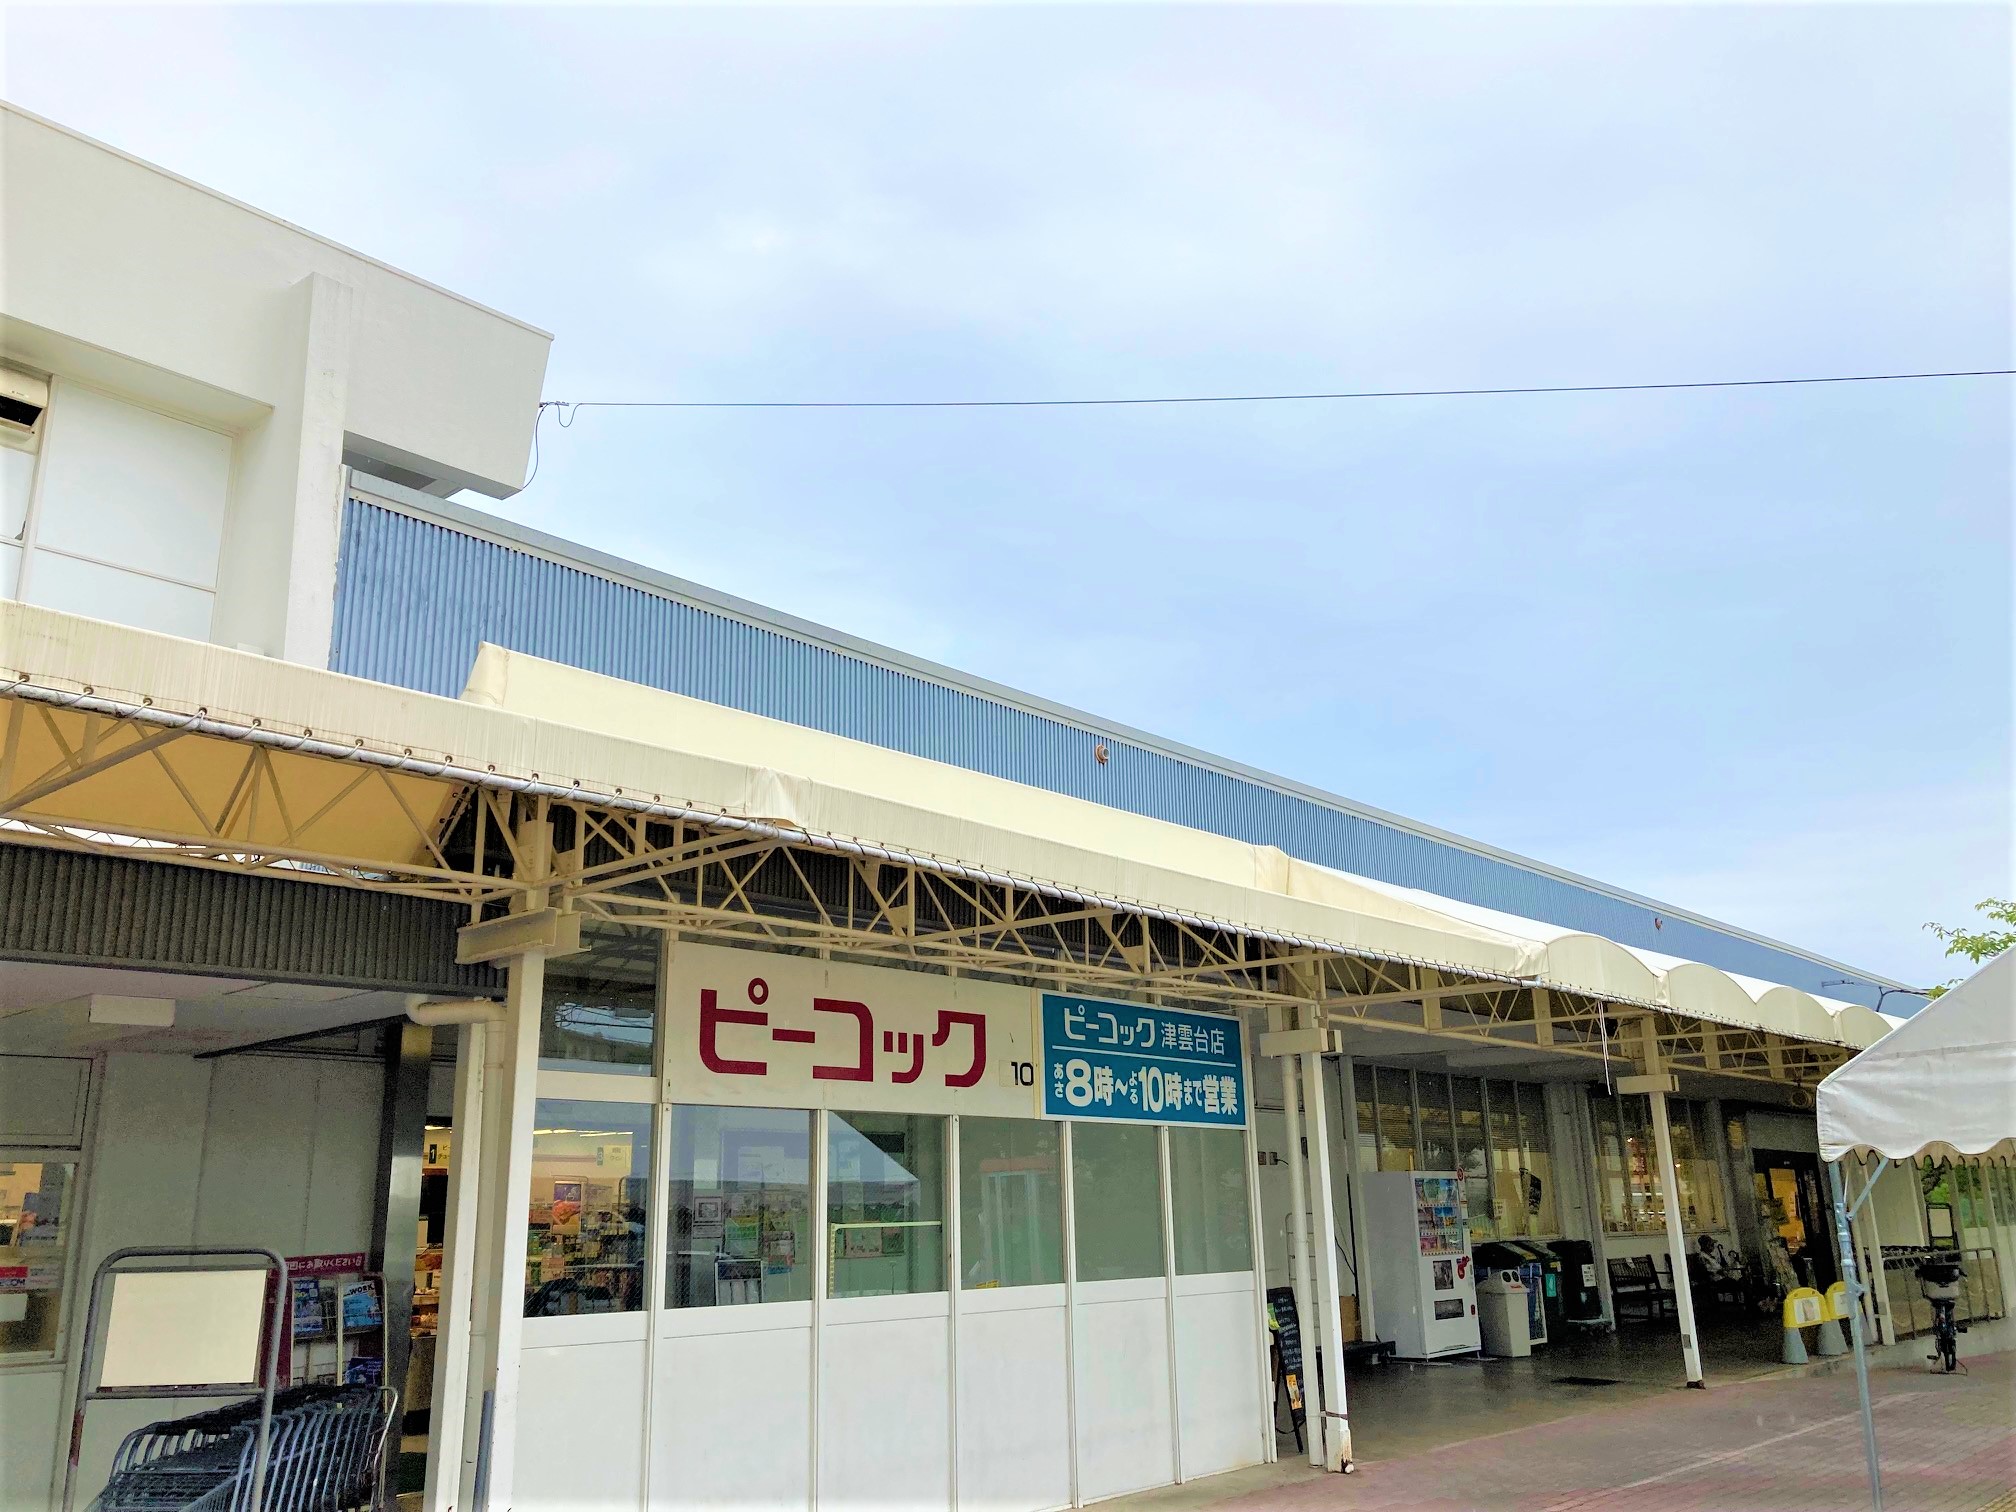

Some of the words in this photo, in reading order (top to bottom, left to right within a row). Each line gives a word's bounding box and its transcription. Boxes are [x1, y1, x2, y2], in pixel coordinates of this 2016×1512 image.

[699, 977, 987, 1088] ピーコック
[1064, 1004, 1155, 1048] ピーコック
[1161, 1021, 1225, 1056] 津雲台店
[1010, 1062, 1034, 1087] 10
